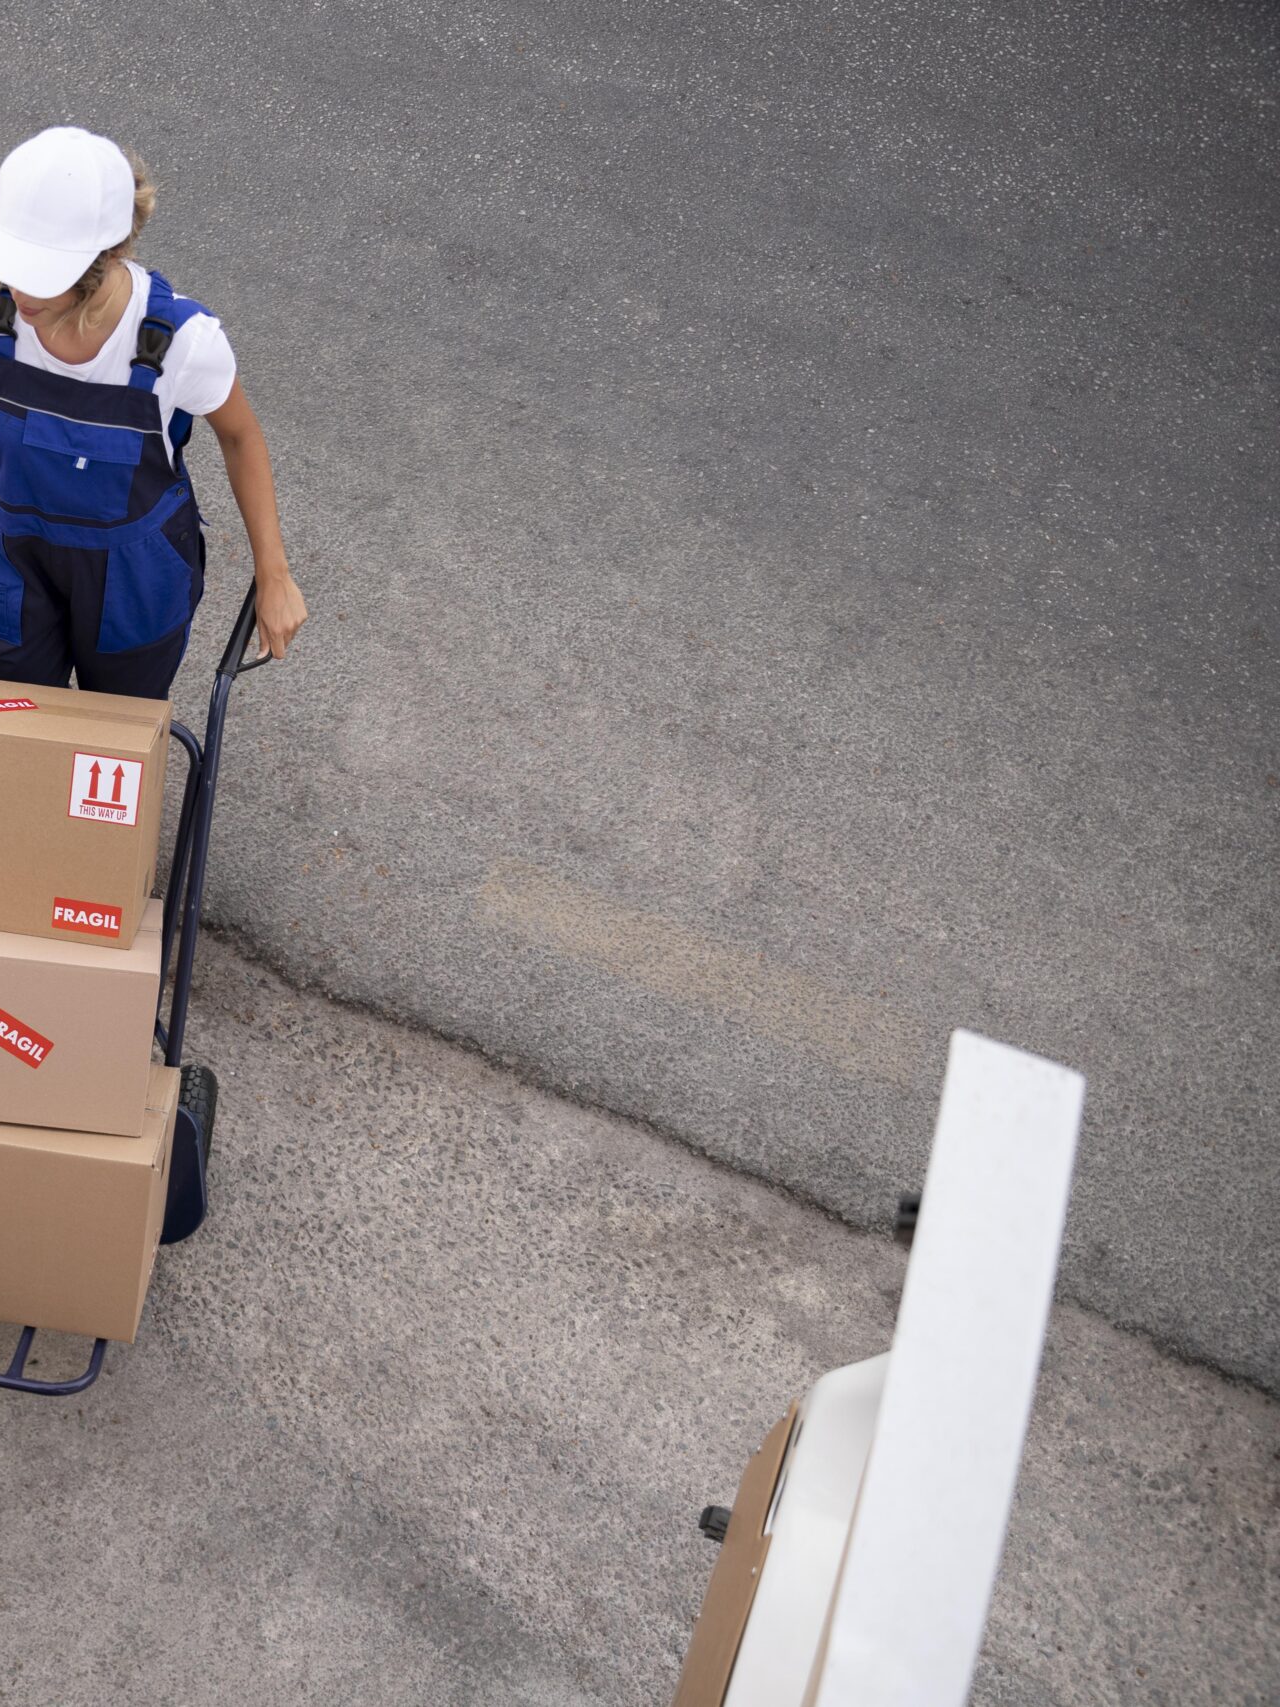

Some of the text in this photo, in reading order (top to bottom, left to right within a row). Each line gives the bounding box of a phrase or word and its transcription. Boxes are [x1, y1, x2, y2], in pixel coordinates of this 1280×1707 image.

[79, 805, 127, 821] THIS WAY UP
[53, 906, 119, 930] FRAGIL
